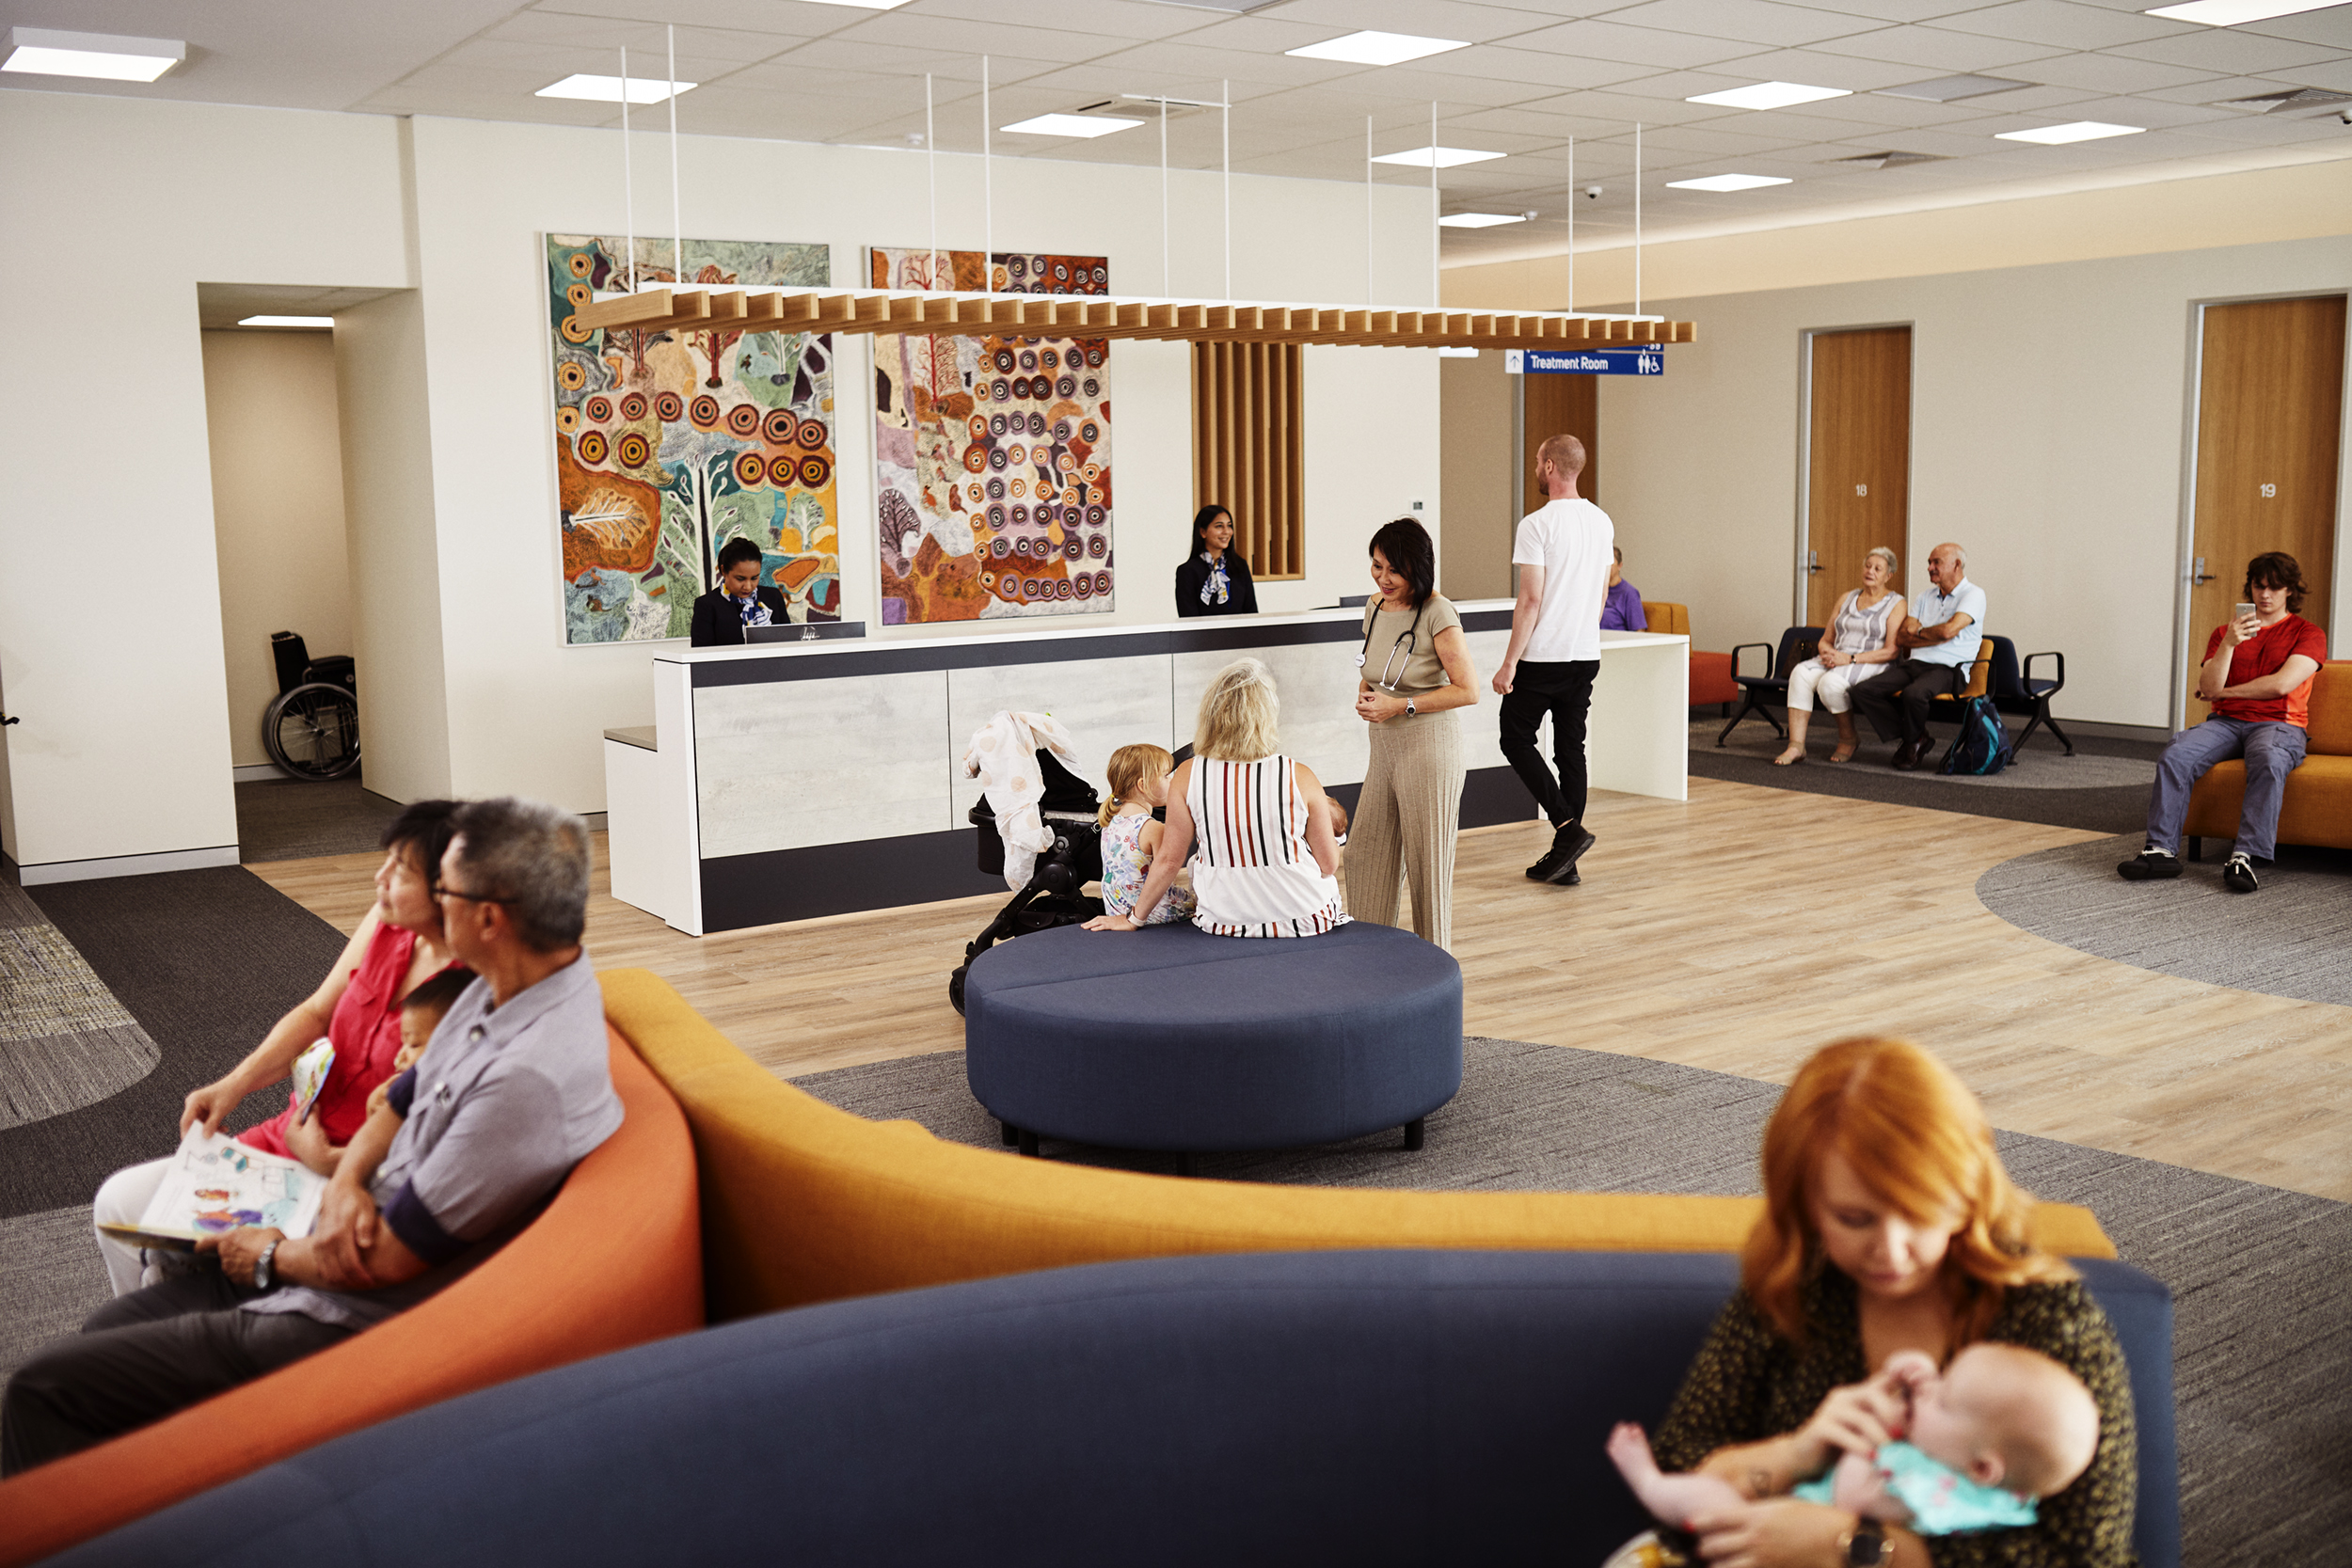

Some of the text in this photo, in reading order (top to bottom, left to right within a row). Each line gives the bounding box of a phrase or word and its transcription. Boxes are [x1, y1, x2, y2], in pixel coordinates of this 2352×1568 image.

[1530, 355, 1609, 371] Treatment Room
[1855, 483, 1867, 497] 18
[2260, 483, 2277, 498] 19
